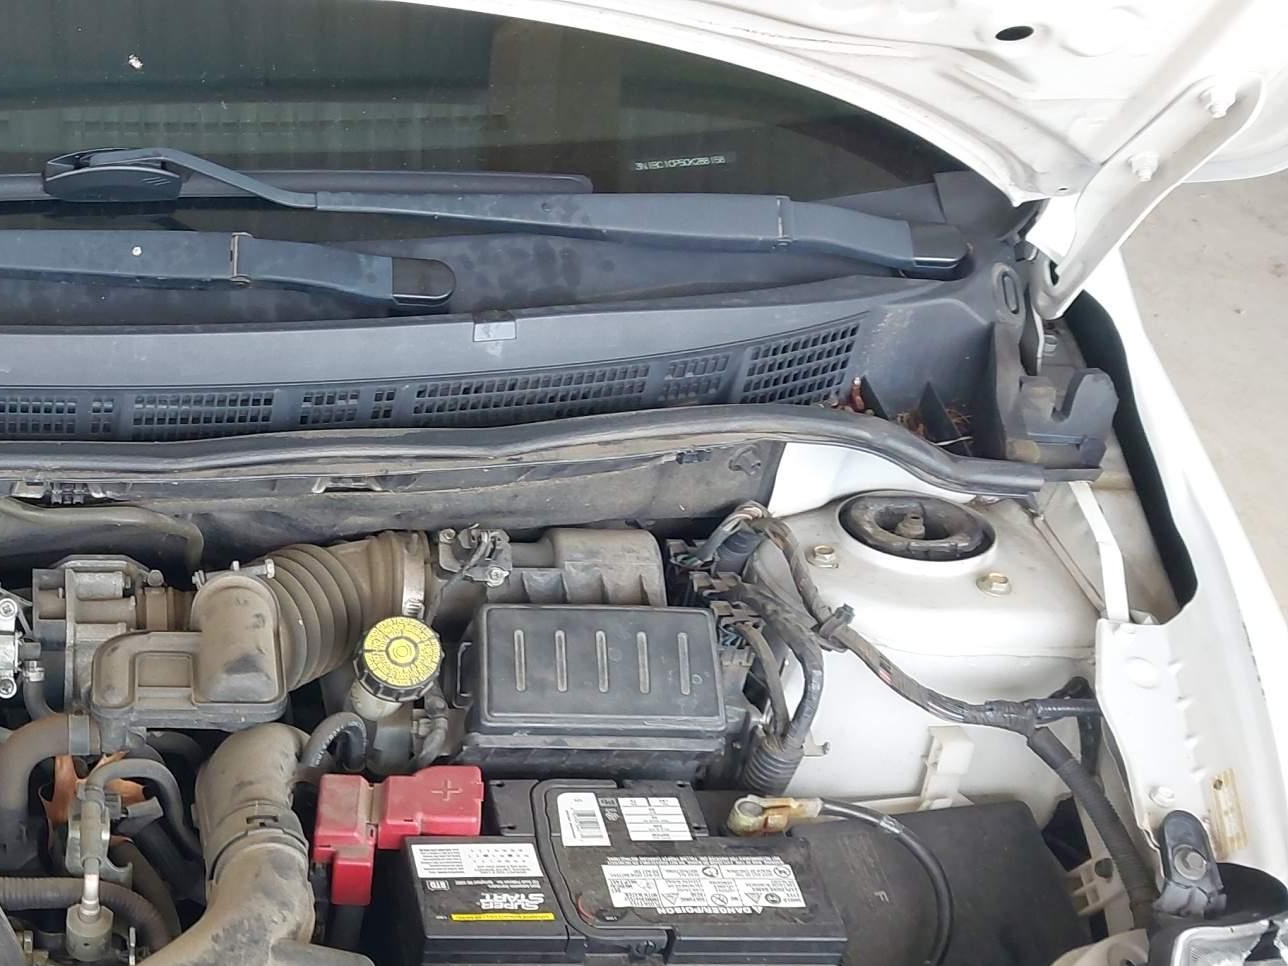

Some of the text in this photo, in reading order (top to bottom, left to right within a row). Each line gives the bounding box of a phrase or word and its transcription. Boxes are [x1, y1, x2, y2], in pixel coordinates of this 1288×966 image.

[479, 892, 545, 904] START
[481, 901, 540, 911] SUPER
[656, 905, 753, 915] DANGER/POISON
